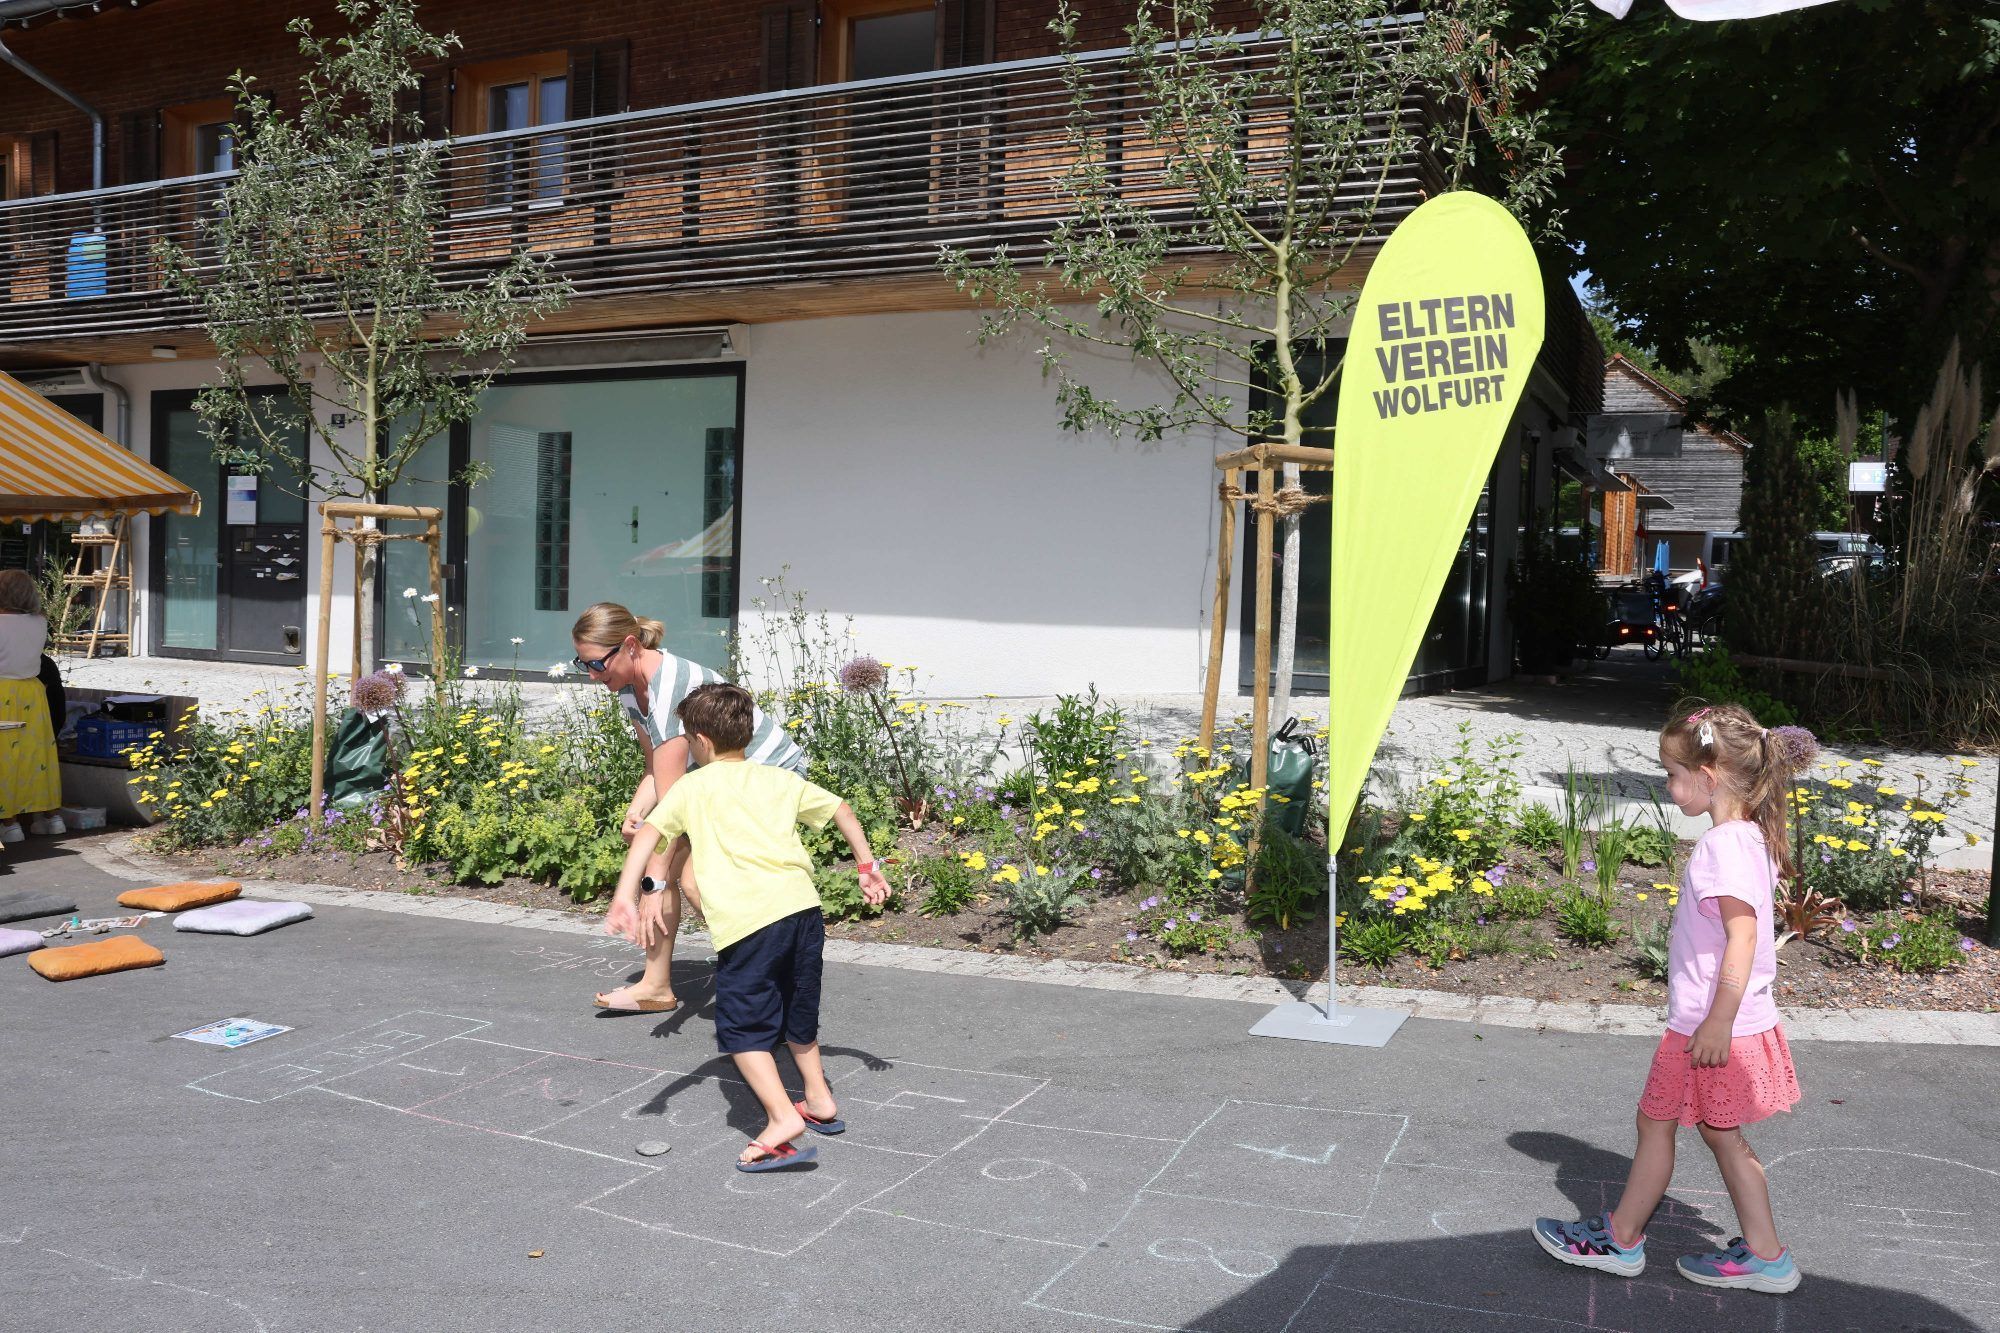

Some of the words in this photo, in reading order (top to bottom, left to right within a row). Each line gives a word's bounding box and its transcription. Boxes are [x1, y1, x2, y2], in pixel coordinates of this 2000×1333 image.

[1377, 293, 1515, 341] ELTERN
[1375, 333, 1508, 383] VEREIN
[1373, 374, 1505, 419] WOLFURT
